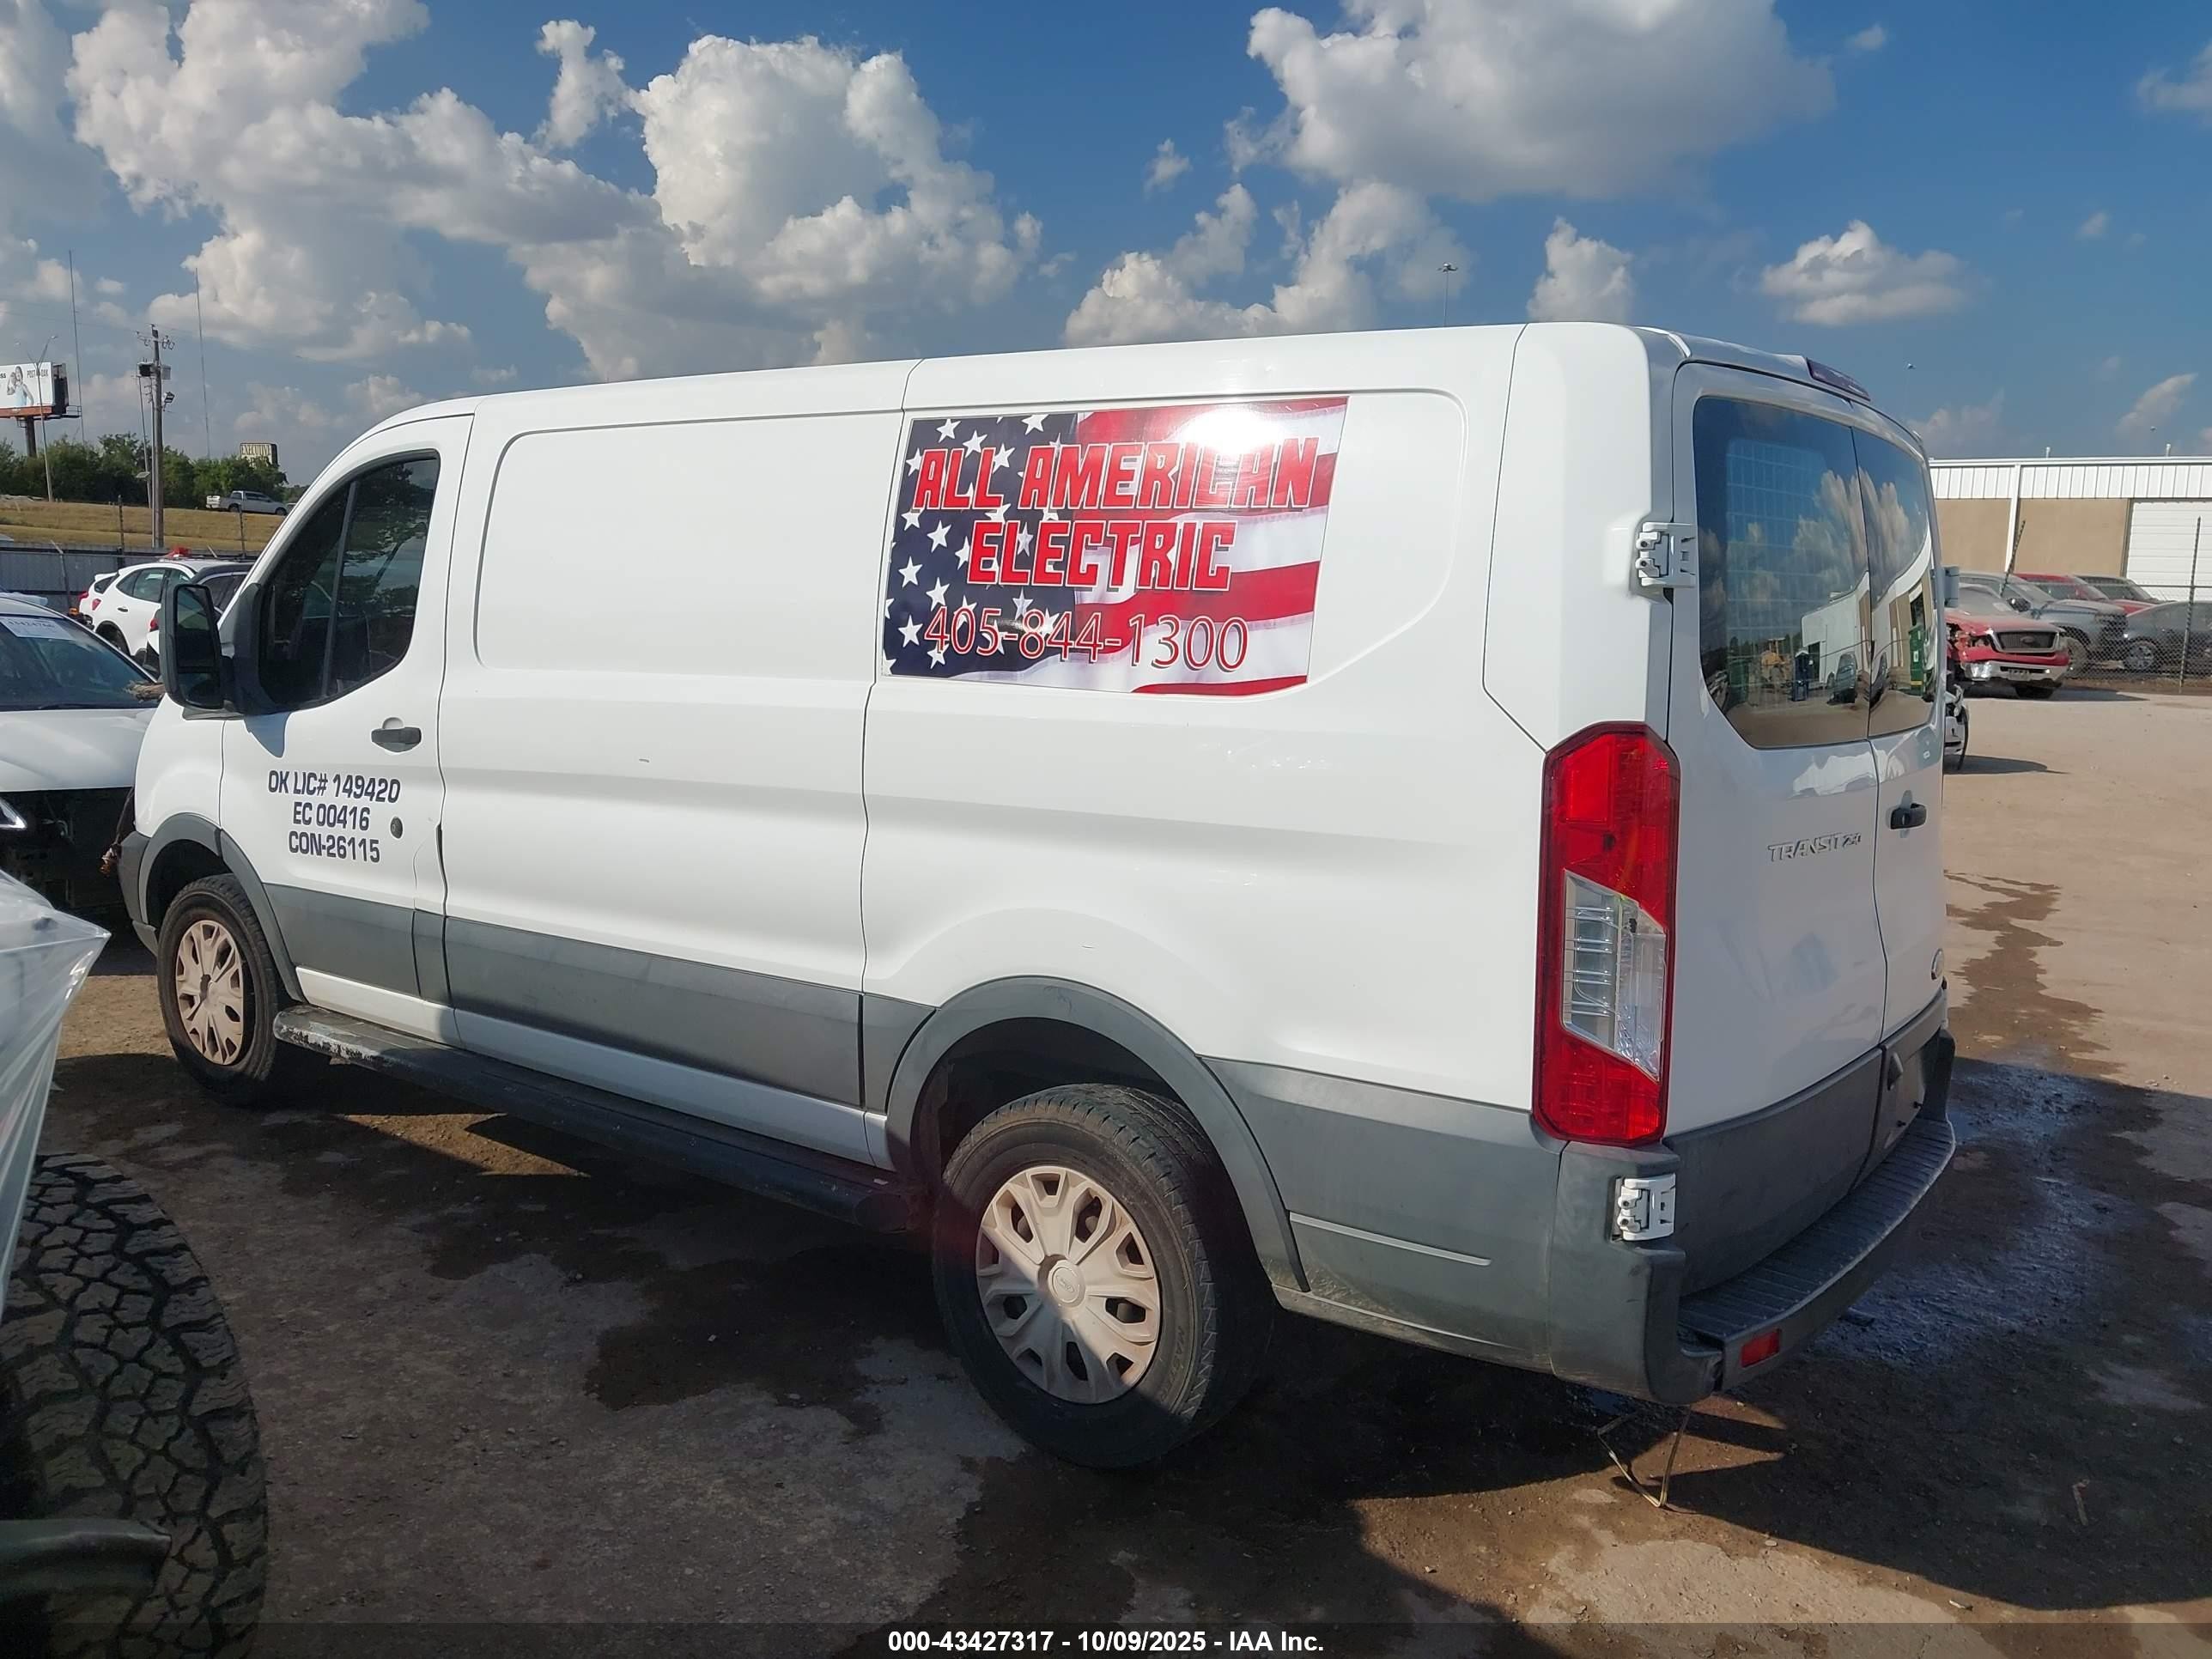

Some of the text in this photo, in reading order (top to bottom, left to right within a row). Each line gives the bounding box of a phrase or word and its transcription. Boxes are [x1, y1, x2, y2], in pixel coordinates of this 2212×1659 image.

[913, 438, 1319, 510] ALL AMERICAN
[967, 520, 1237, 591] ELECTRIC
[924, 606, 1249, 672] 405-844-1300
[269, 770, 400, 803] OK LIC# 149420
[293, 802, 370, 830] EC 00416
[289, 831, 380, 863] CON-26115
[1768, 834, 1839, 861] TRANSIT
